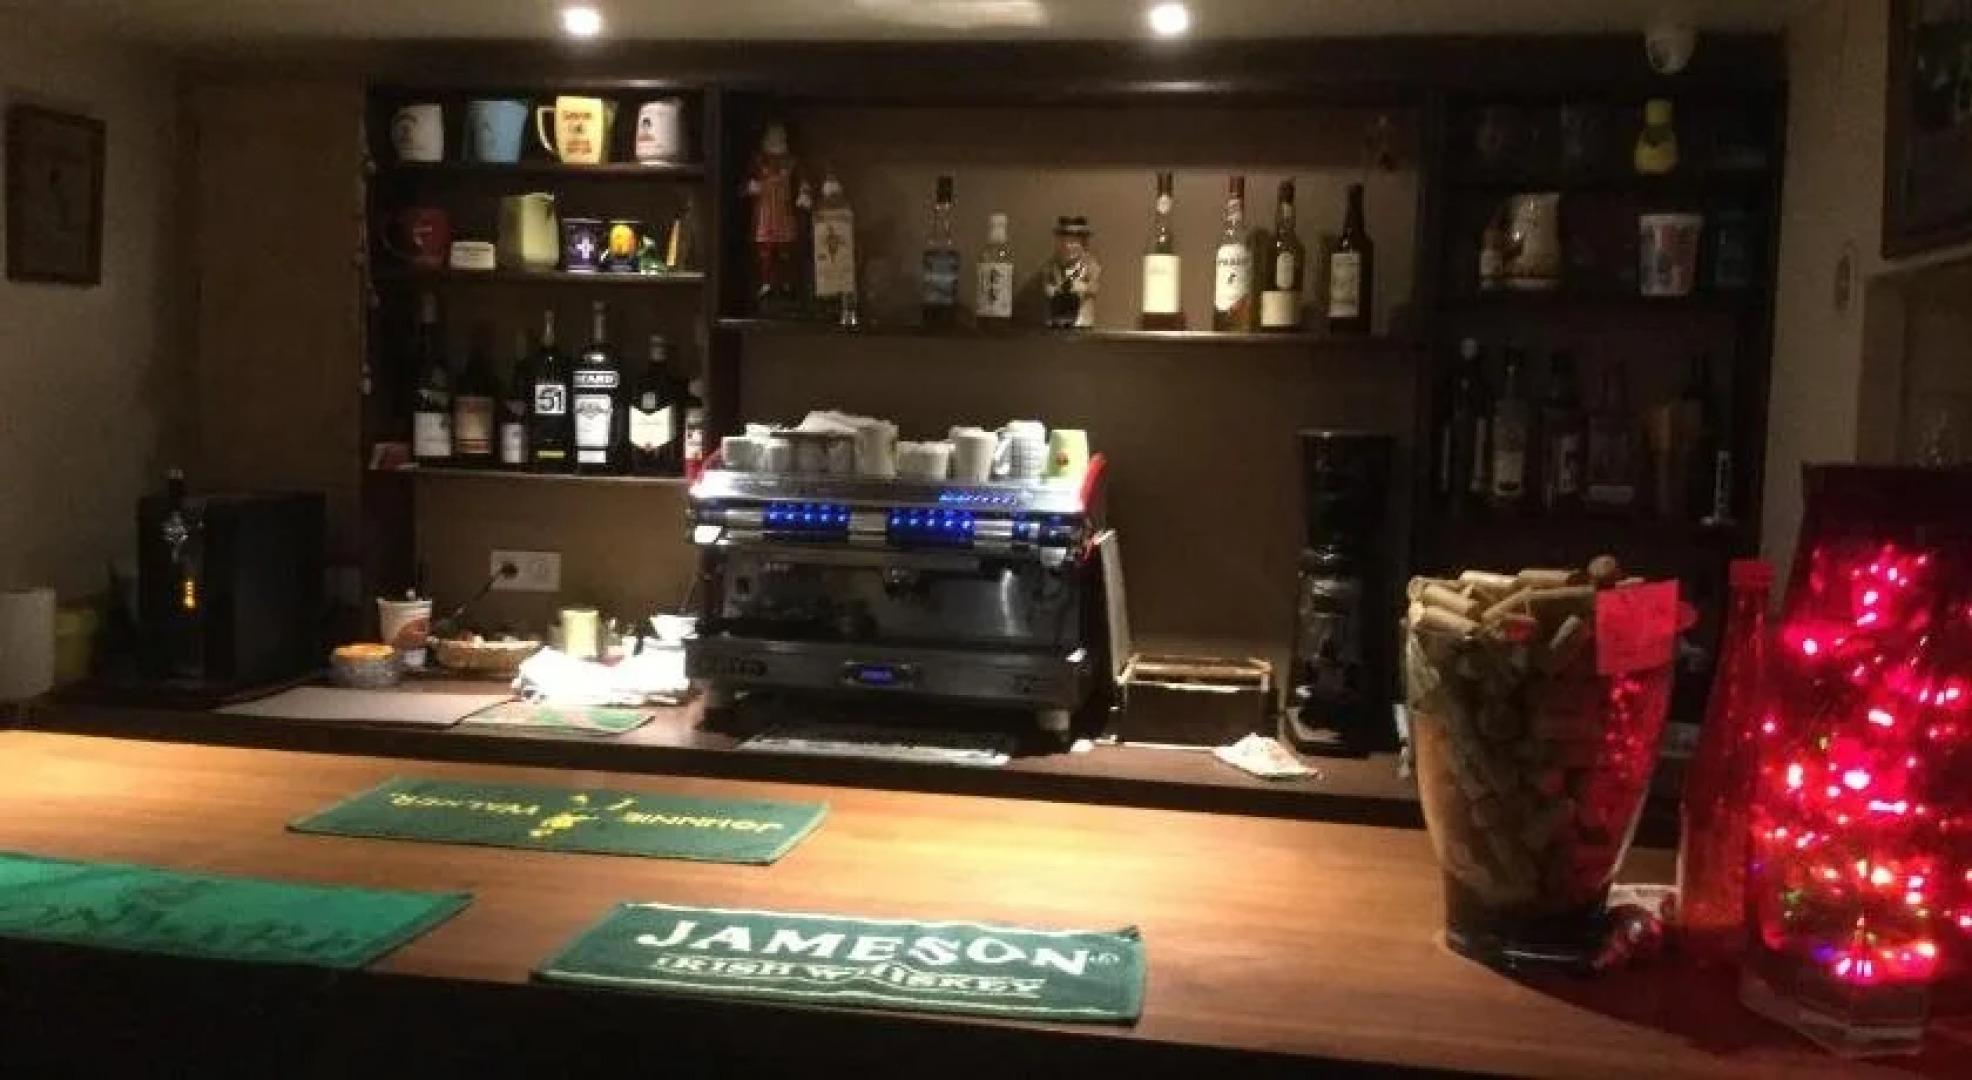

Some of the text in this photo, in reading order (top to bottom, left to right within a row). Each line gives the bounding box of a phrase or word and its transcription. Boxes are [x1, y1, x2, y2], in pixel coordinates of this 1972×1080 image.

[537, 386, 562, 411] 51
[634, 919, 1091, 976] JAMESON
[654, 955, 796, 979] IRISH
